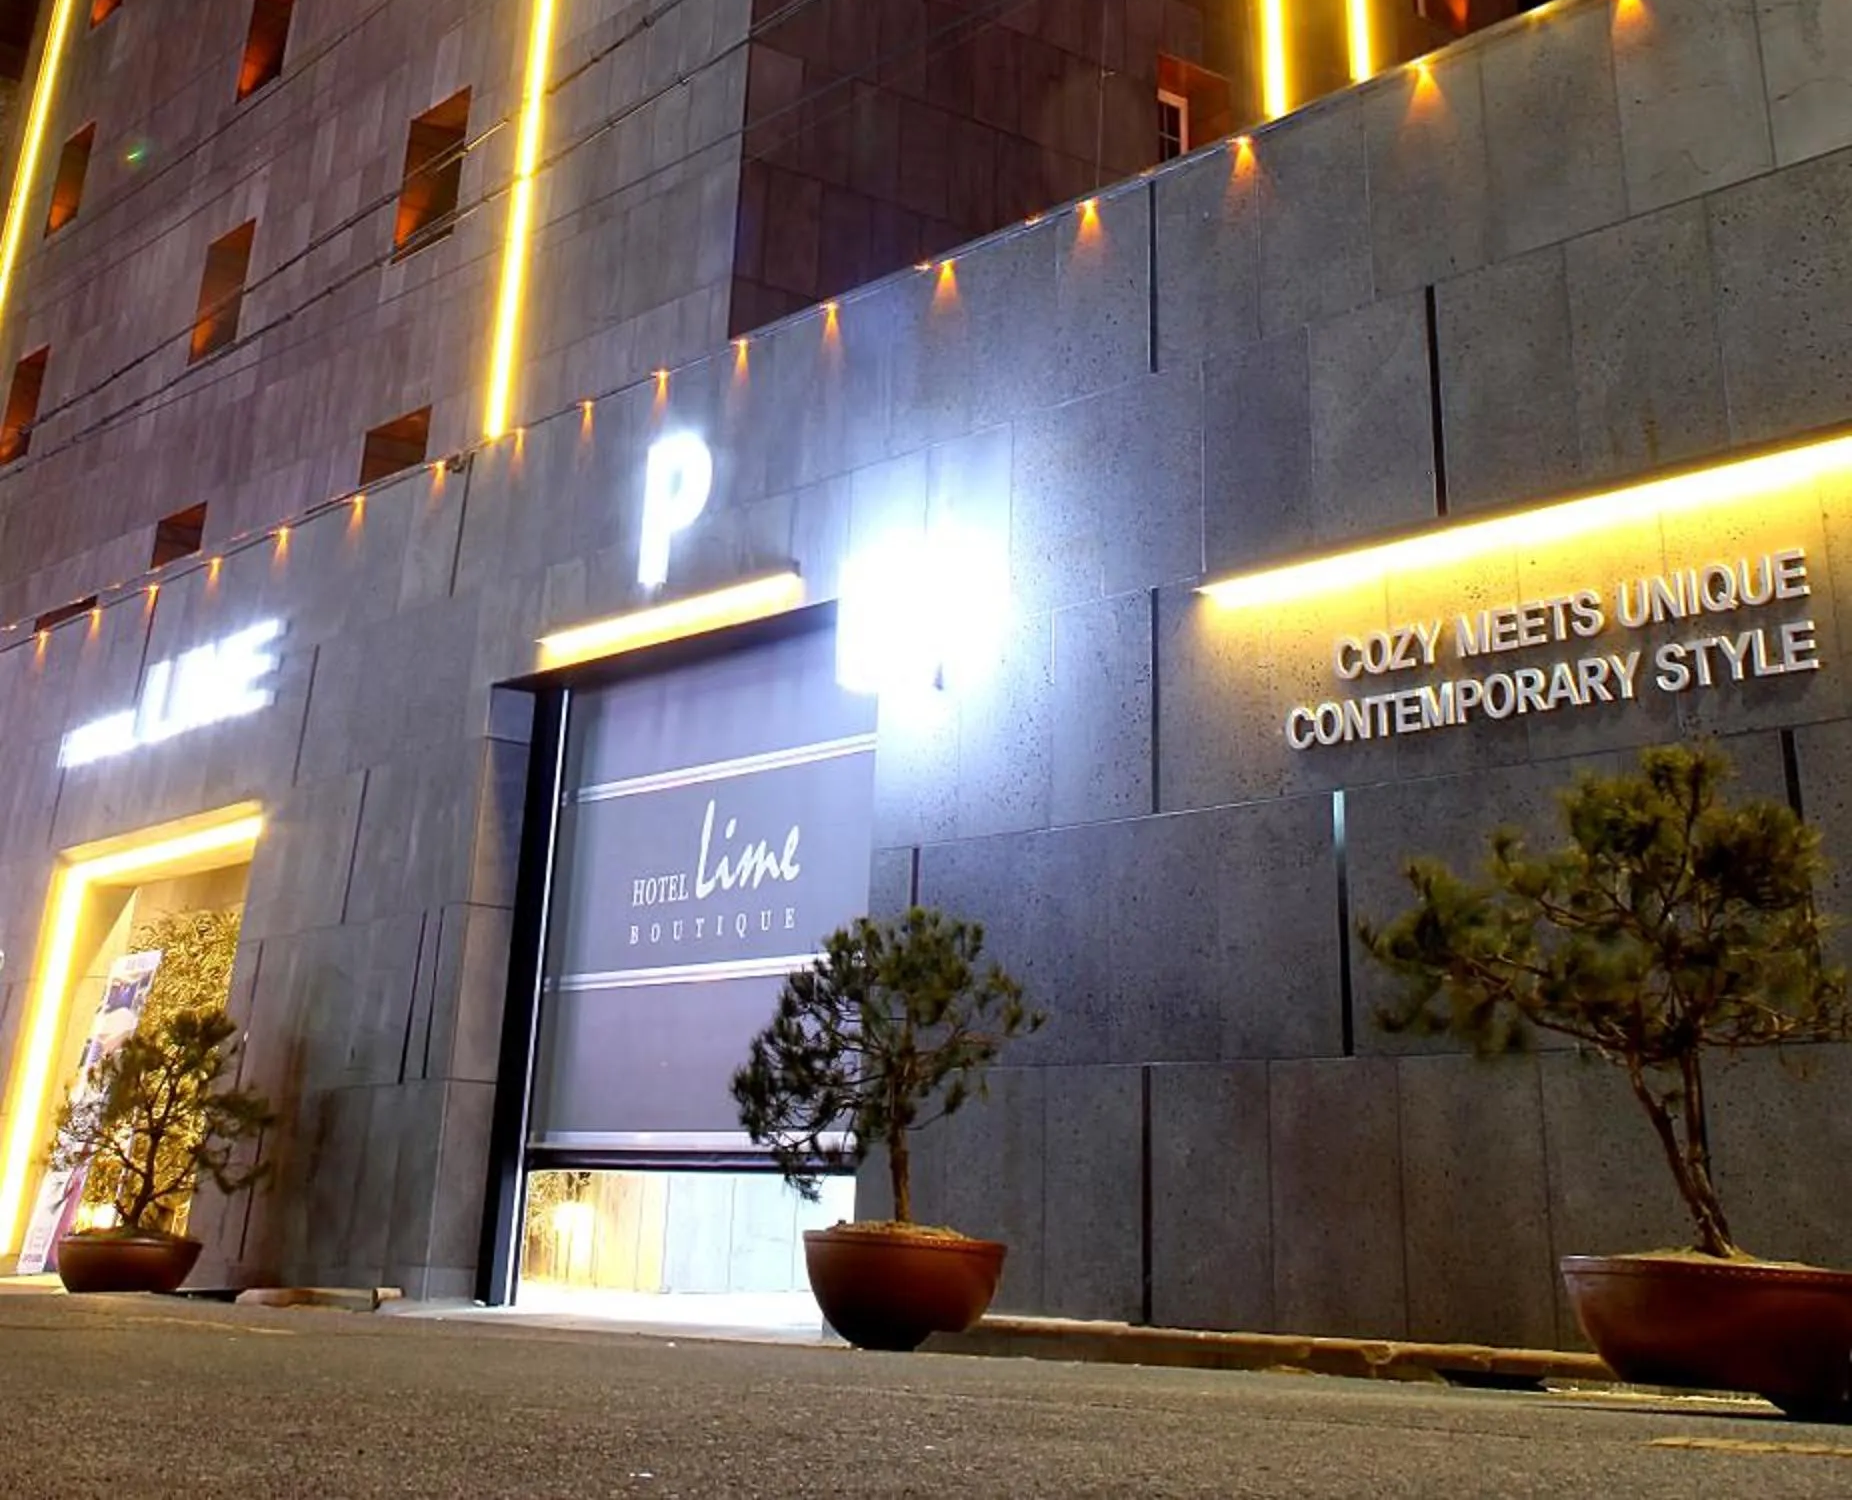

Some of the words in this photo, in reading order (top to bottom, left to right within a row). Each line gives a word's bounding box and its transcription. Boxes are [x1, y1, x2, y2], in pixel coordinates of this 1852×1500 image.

[637, 430, 714, 584] P
[1333, 621, 1442, 680] COZY
[1454, 590, 1605, 658] MEETS
[1616, 547, 1811, 630] UNIQUE
[1285, 652, 1641, 750] CONTEMPORARY
[1655, 620, 1821, 692] STYLE
[632, 873, 689, 907] HOTEL
[695, 799, 800, 899] Lime
[629, 907, 796, 945] BOUTIQUE
